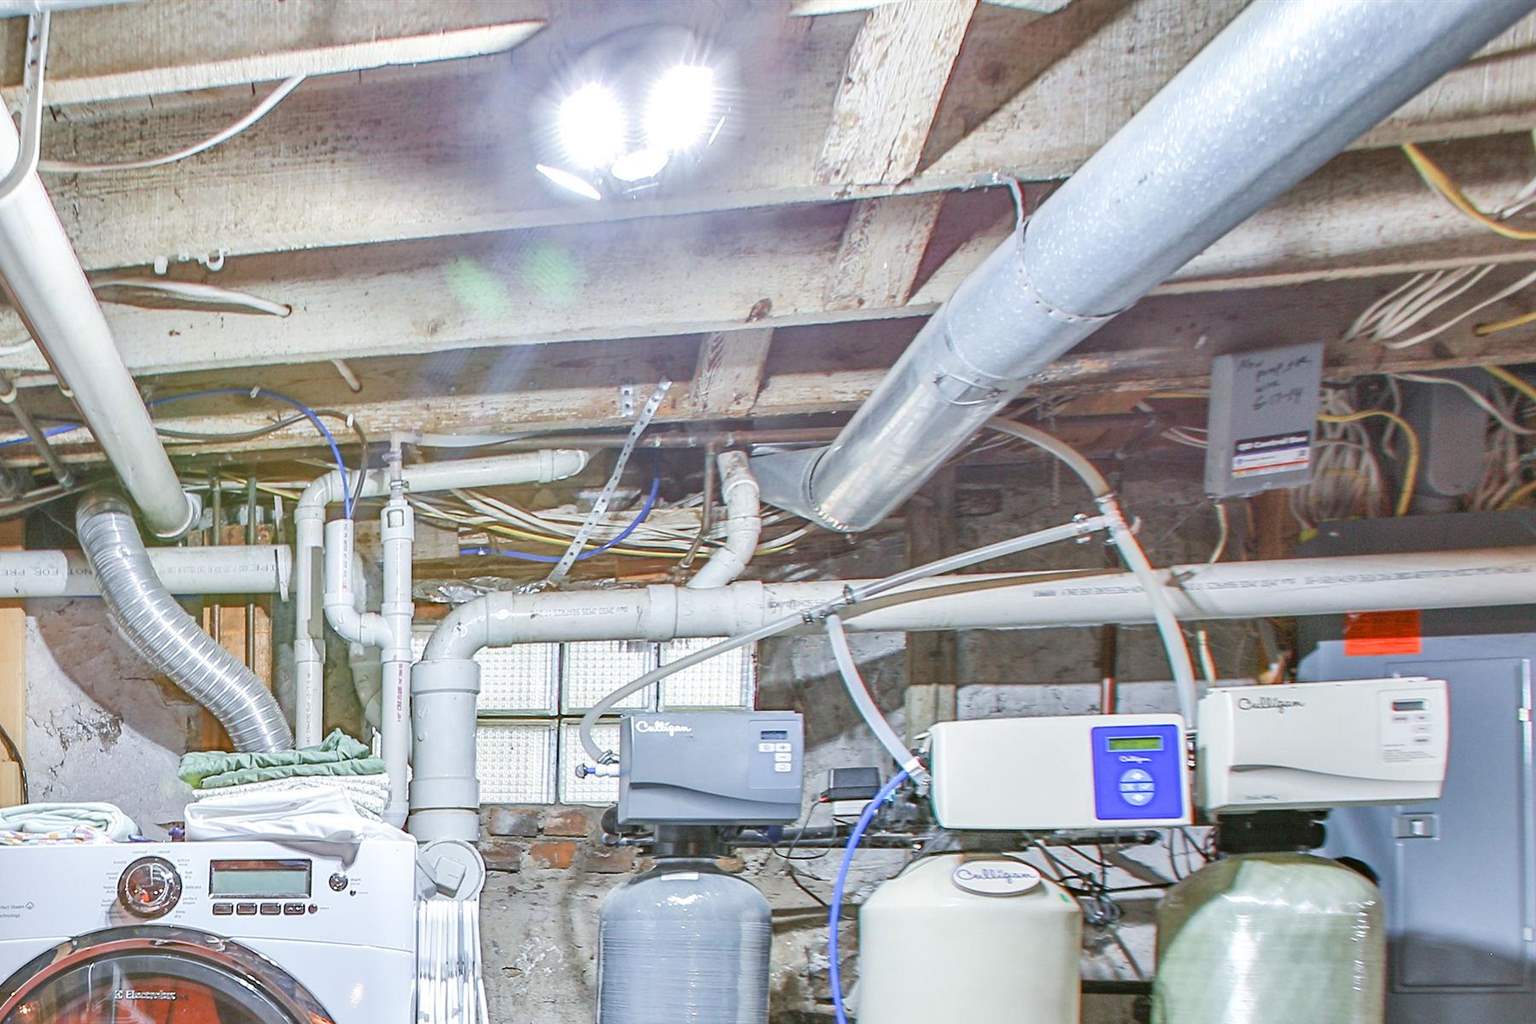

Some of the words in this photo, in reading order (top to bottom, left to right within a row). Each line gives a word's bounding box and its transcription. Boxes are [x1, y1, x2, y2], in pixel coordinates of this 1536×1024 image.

[1236, 696, 1306, 714] Culligan
[635, 720, 692, 737] Culligan
[956, 868, 1038, 884] Culligan
